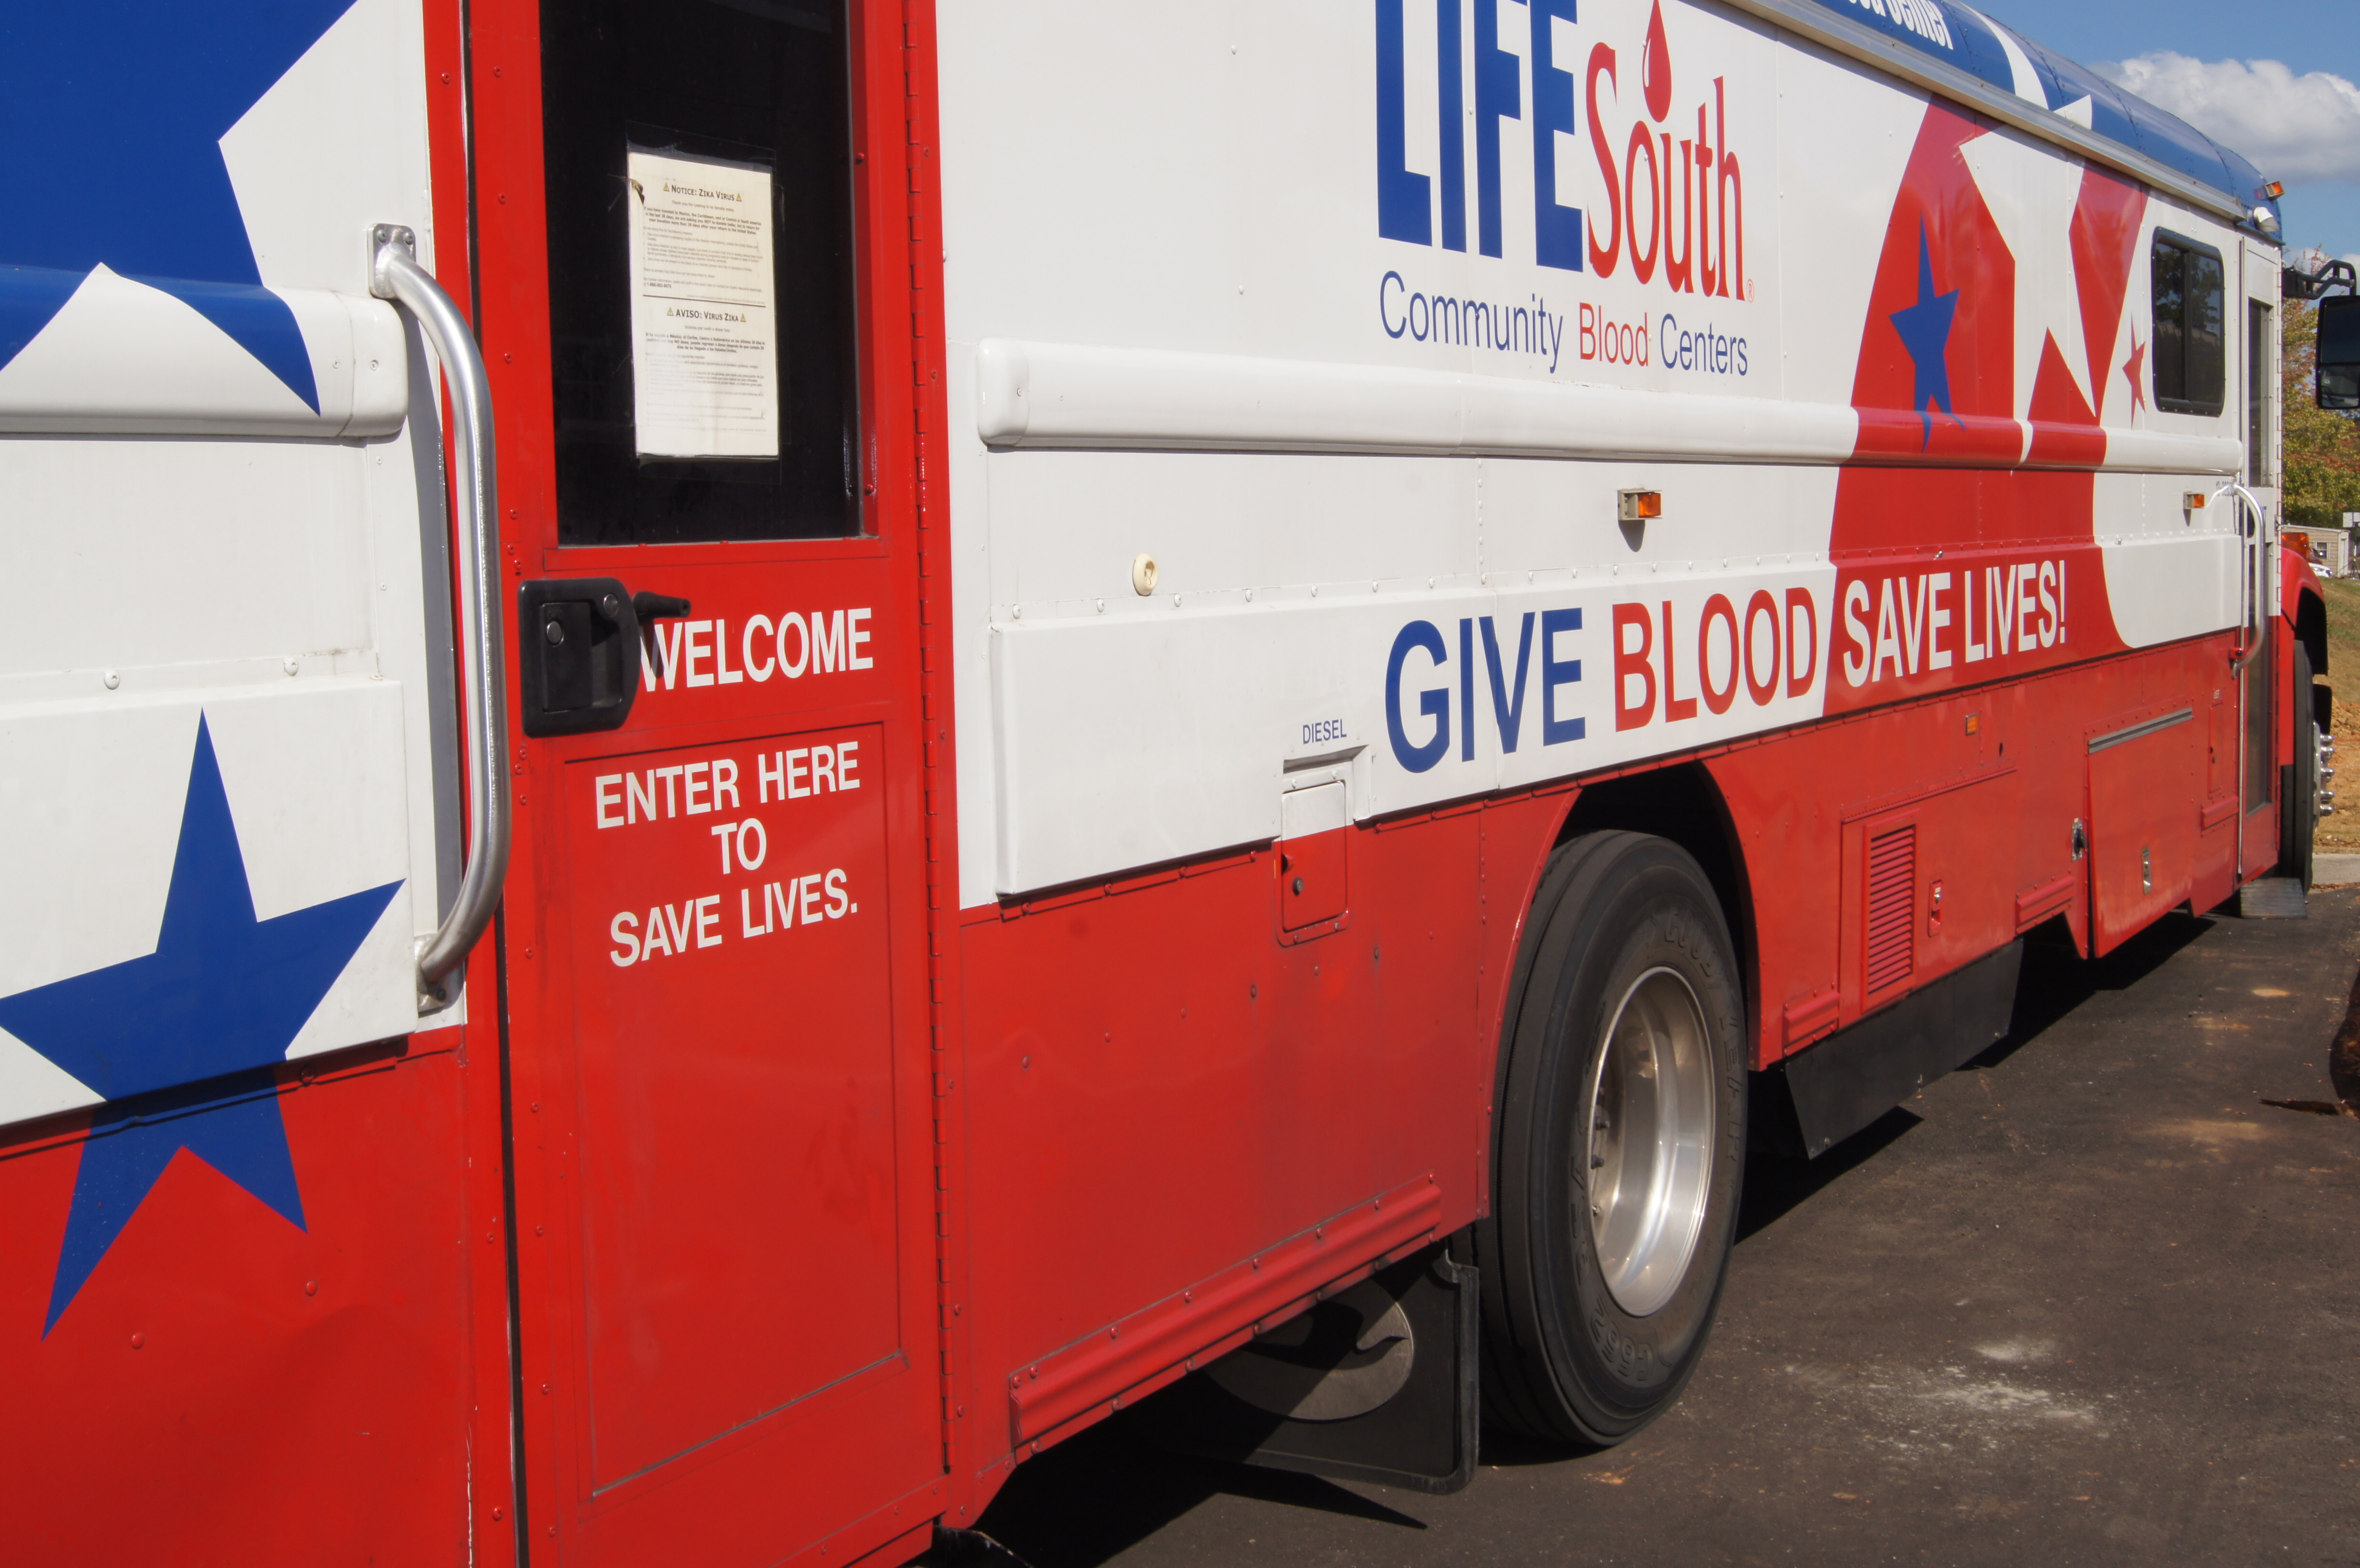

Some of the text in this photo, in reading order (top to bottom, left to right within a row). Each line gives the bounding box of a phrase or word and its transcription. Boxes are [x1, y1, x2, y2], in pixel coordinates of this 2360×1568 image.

[672, 185, 735, 201] NOTICE: ZIKA VIRUS
[676, 309, 738, 322] AVISO: VIRUS ZIKA
[1380, 270, 1748, 376] Community Blood Centers
[640, 607, 873, 692] WELCOME
[1386, 560, 2066, 773] GIVE BLOOD SAVE LIVES!
[1303, 719, 1347, 744] DIESEL
[596, 741, 860, 829] ENTER HERE
[712, 818, 767, 874] TO
[610, 869, 858, 967] SAVE LIVES.
